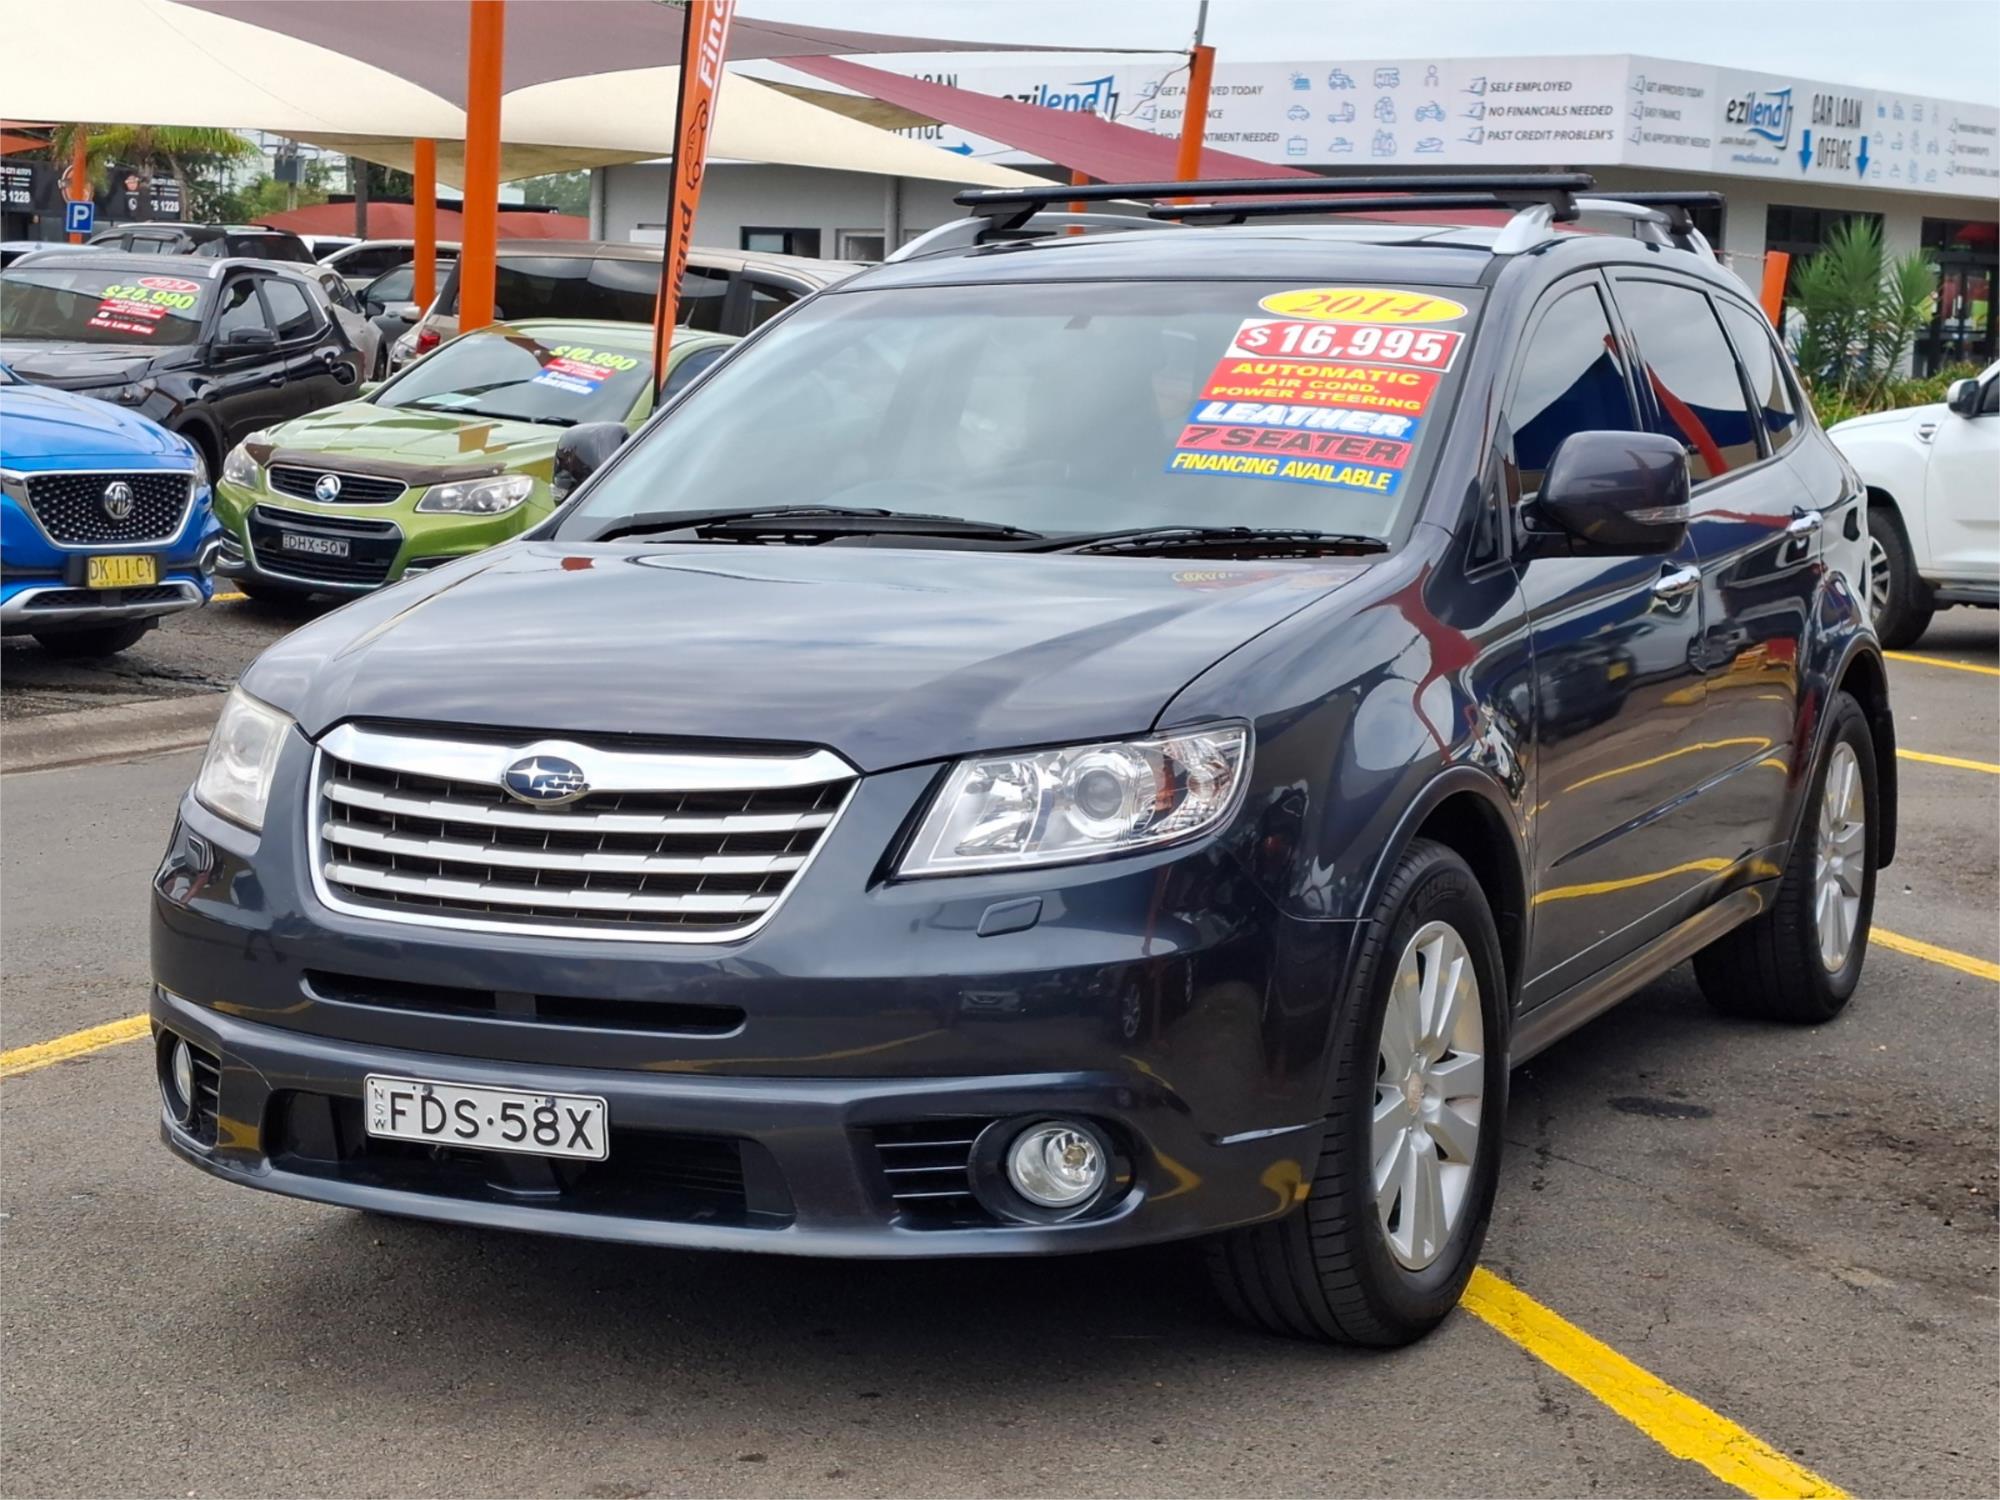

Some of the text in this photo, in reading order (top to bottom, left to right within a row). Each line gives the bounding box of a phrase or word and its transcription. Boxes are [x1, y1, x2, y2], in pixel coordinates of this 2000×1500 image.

[1161, 86, 1179, 96] GET
[1231, 86, 1264, 96] TODAY
[1490, 81, 1573, 92] SELF EMPLOYED
[1160, 109, 1183, 119] EASY
[1489, 105, 1614, 117] NO FINANCIALS NEEDED
[1726, 91, 1783, 128] ezilend
[1812, 93, 1862, 129] CAR LOAN
[1242, 132, 1280, 142] NEEDED
[1487, 129, 1614, 141] PAST CREDIT PROBLEM'S
[1817, 136, 1851, 169] OFFICE
[8, 190, 31, 203] 1228
[160, 200, 180, 212] 1228
[73, 205, 90, 228] P
[1287, 294, 1436, 318] 2014
[1231, 363, 1421, 386] AUTOMATIC
[1261, 378, 1381, 394] AIR COND.
[1211, 386, 1421, 411] POWER STEERING
[1196, 401, 1412, 438] LEATHER
[1183, 427, 1406, 463] 7 SEATER
[1171, 453, 1393, 491] FINANCING AVAILABLE
